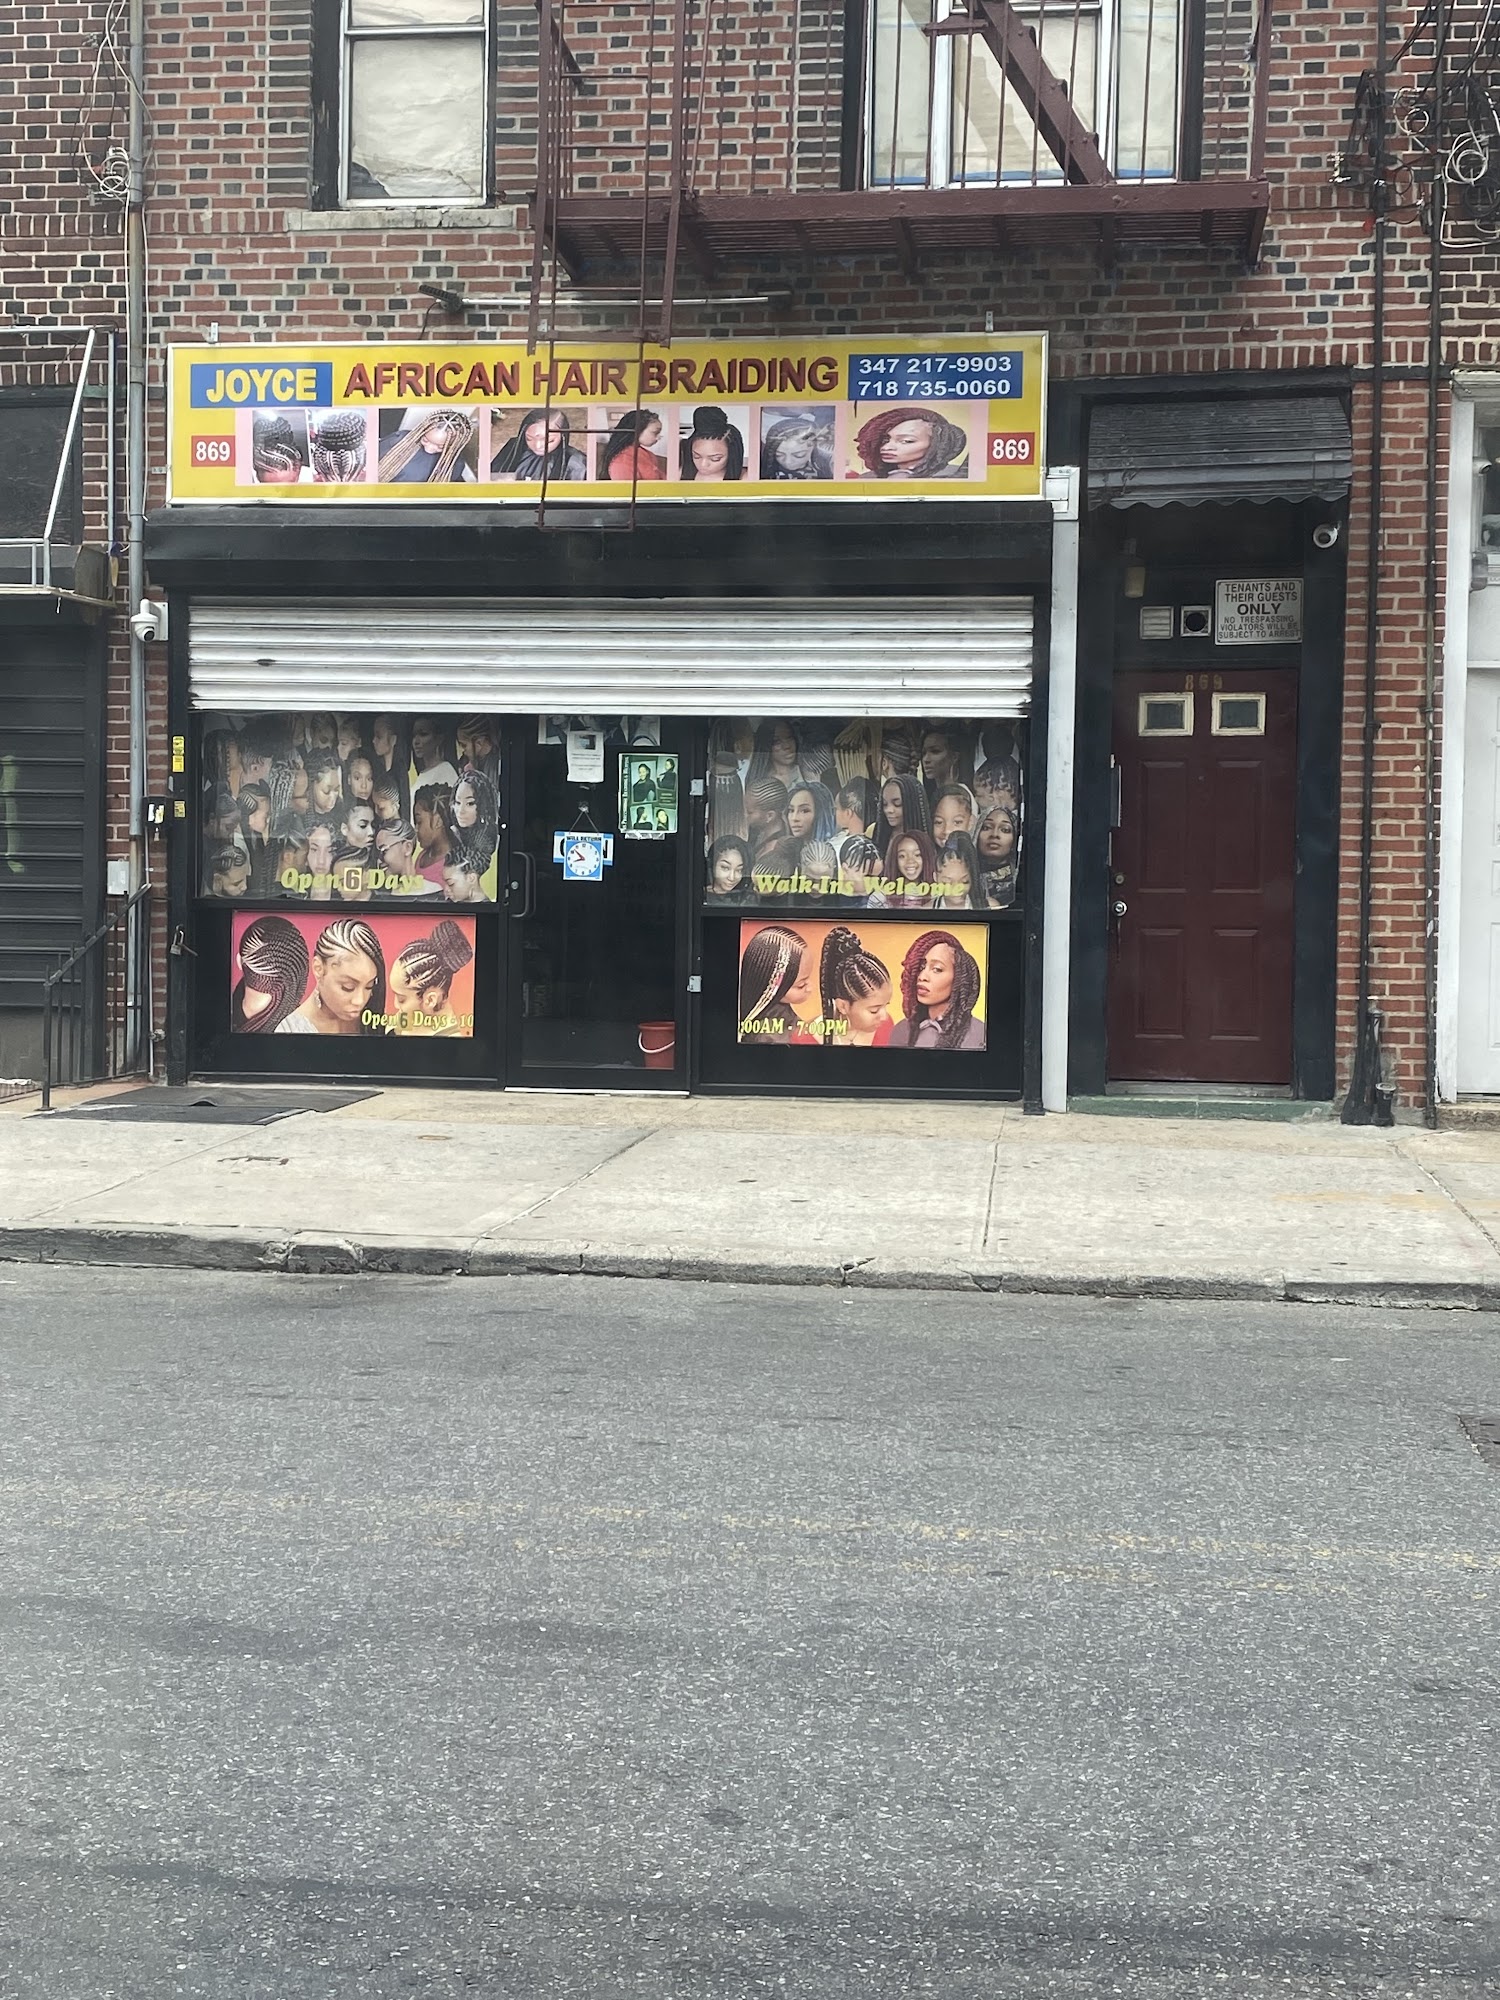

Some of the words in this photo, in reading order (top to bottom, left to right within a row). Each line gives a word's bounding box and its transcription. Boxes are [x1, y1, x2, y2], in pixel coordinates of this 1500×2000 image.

[858, 358, 900, 374] 347
[906, 356, 1012, 373] 217-9903
[206, 368, 317, 403] JOYCE
[343, 361, 520, 397] AFRICAN
[533, 360, 628, 396] HAIR
[640, 356, 839, 394] BRAIDING
[858, 381, 899, 396] 718
[906, 379, 1011, 396] 735-0060
[195, 441, 231, 462] 869
[992, 438, 1030, 460] 869
[1224, 582, 1271, 592] TENANTS
[1274, 581, 1296, 591] AND
[1224, 593, 1254, 602] THEIR
[1257, 591, 1298, 602] GUESTS
[1237, 602, 1282, 615] ONLY
[1220, 623, 1265, 631] VIOLATORS
[1266, 622, 1285, 630] WILL
[1287, 622, 1298, 630] BE
[1224, 616, 1236, 624] NO
[1240, 615, 1294, 624] TRESPASSING
[1218, 631, 1254, 639] SUBJECT
[1256, 630, 1267, 638] TO
[1268, 629, 1299, 638] ARREST
[281, 868, 344, 893] Open
[345, 869, 361, 889] 6
[367, 868, 424, 893] Days
[755, 875, 855, 896] Walk-Ins
[863, 876, 966, 897] Welcome
[361, 1009, 398, 1030] Open
[400, 1012, 409, 1029] 6
[413, 1010, 448, 1030] Days
[796, 1019, 848, 1037] 7:00PM
